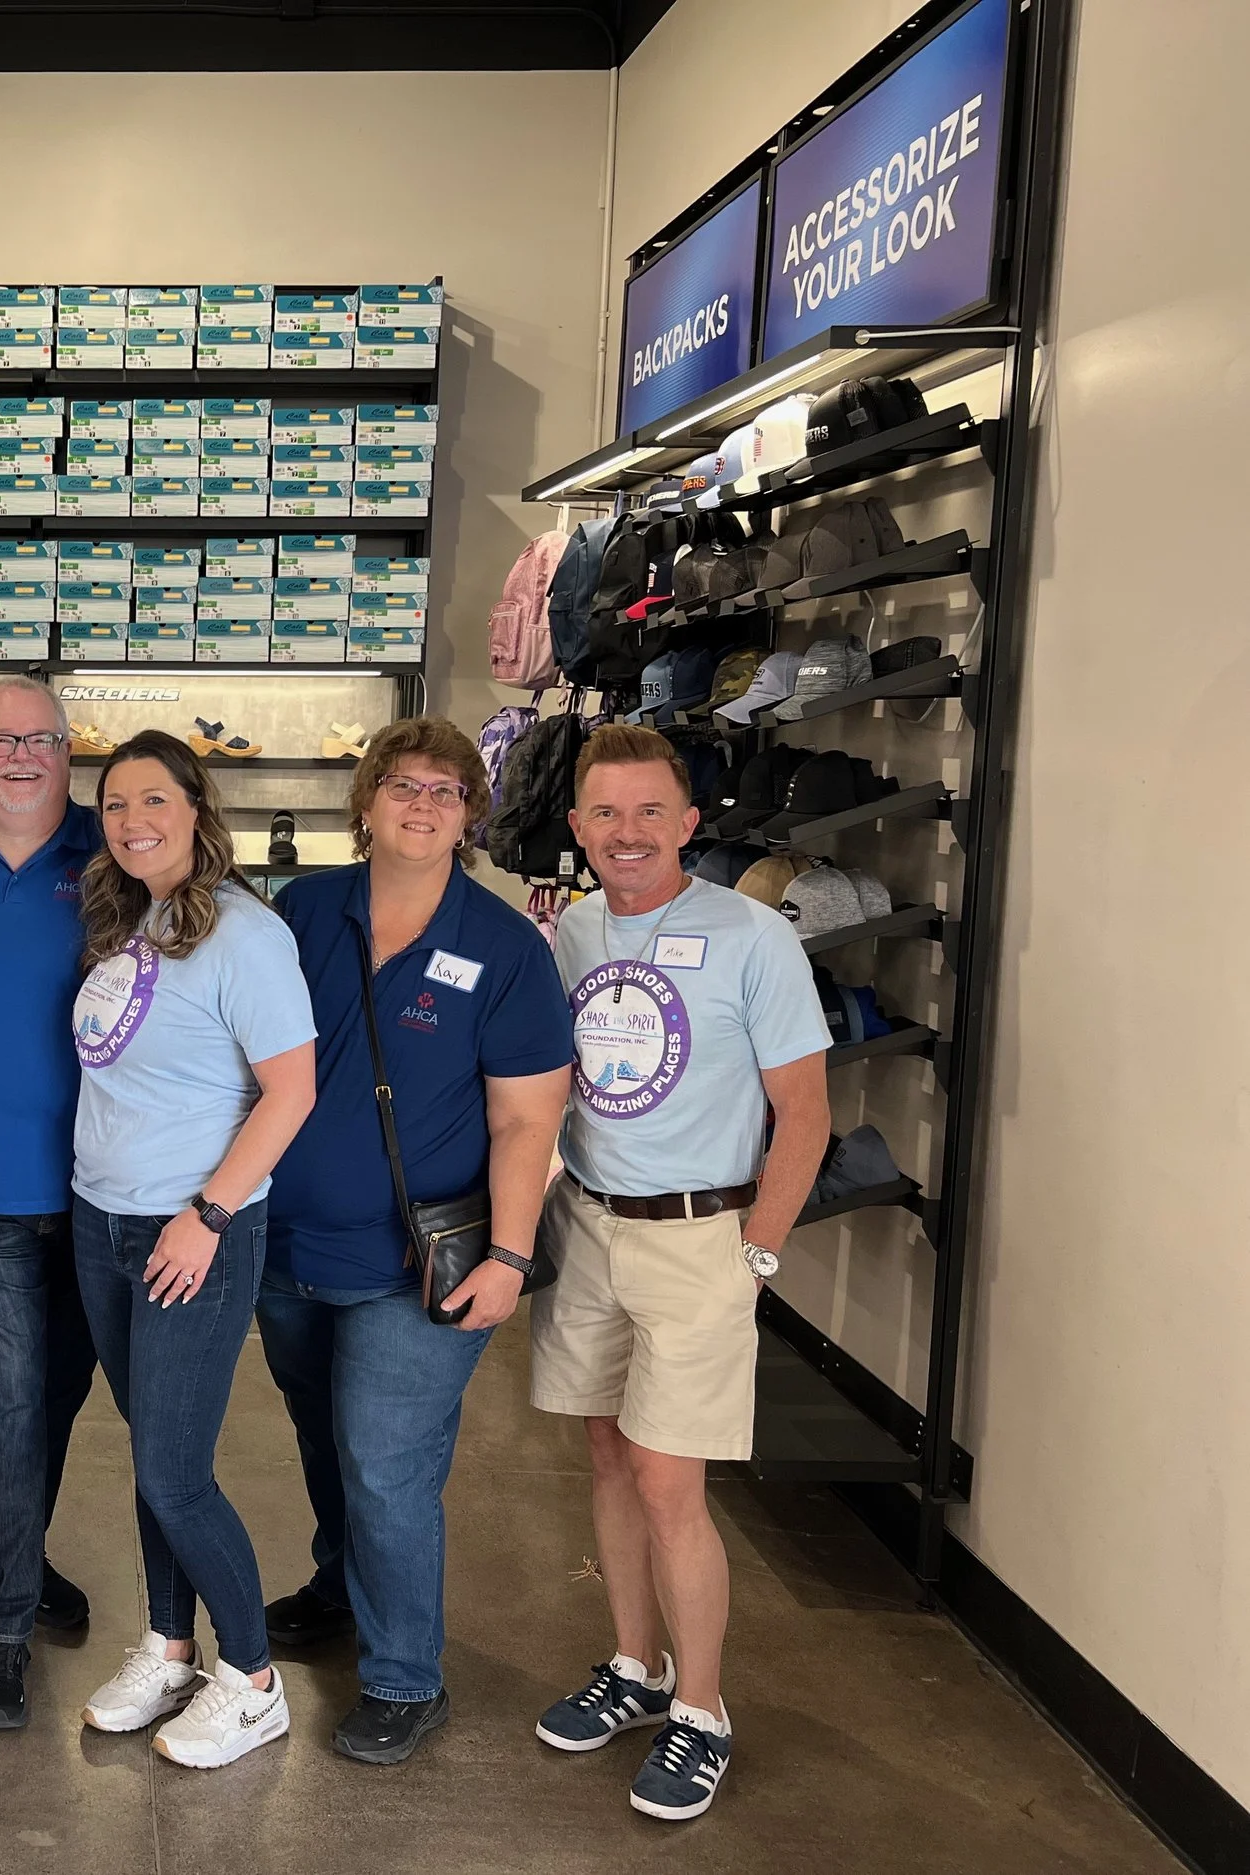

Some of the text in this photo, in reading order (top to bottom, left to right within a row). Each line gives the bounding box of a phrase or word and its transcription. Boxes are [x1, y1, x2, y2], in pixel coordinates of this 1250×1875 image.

[783, 93, 983, 274] ACCESSORIZE
[794, 175, 960, 318] YOUR LOOK
[633, 294, 729, 386] BACKPACKS
[60, 686, 180, 701] SKECHERS
[55, 882, 80, 893] AHC
[433, 956, 463, 985] Kay
[577, 966, 674, 1006] GOOD SHOES
[109, 997, 143, 1051] PLACES
[401, 1006, 438, 1025] AHCA
[579, 1012, 610, 1027] SHARE
[627, 1014, 657, 1030] SPIRIT
[582, 1034, 633, 1045] FOUNDATION,
[591, 1090, 654, 1113] AMAZING
[652, 1032, 681, 1094] PLACES
